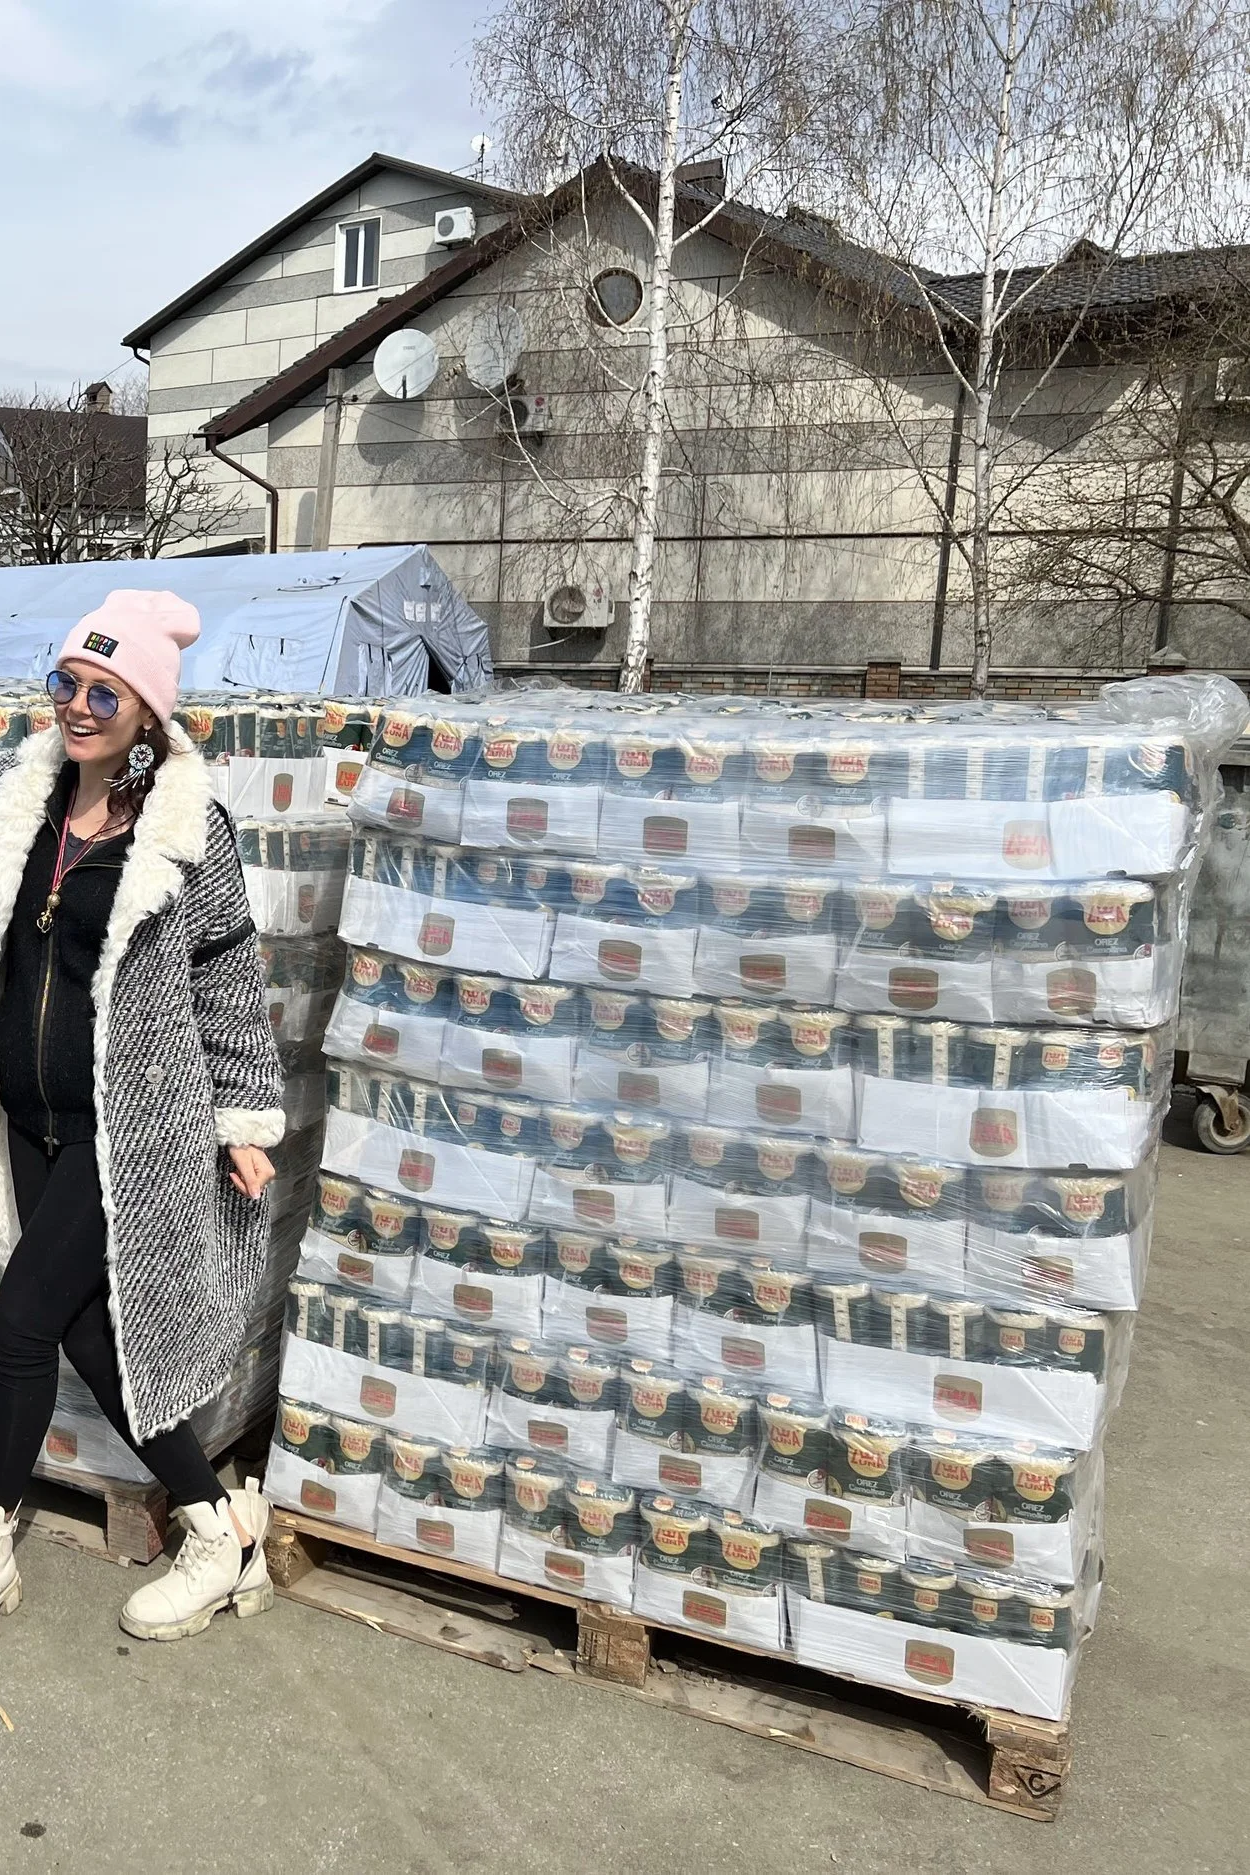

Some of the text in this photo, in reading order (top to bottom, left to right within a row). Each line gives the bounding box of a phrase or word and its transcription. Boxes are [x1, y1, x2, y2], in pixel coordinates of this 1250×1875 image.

[91, 634, 113, 645] HAPPY
[87, 641, 109, 654] NOISE
[382, 747, 398, 758] OREZ
[1094, 938, 1119, 947] OREZ
[856, 1479, 878, 1488] OREZ
[939, 1491, 961, 1499] OREZ
[1021, 1502, 1045, 1511] OREZ
[1029, 1774, 1045, 1792] C
